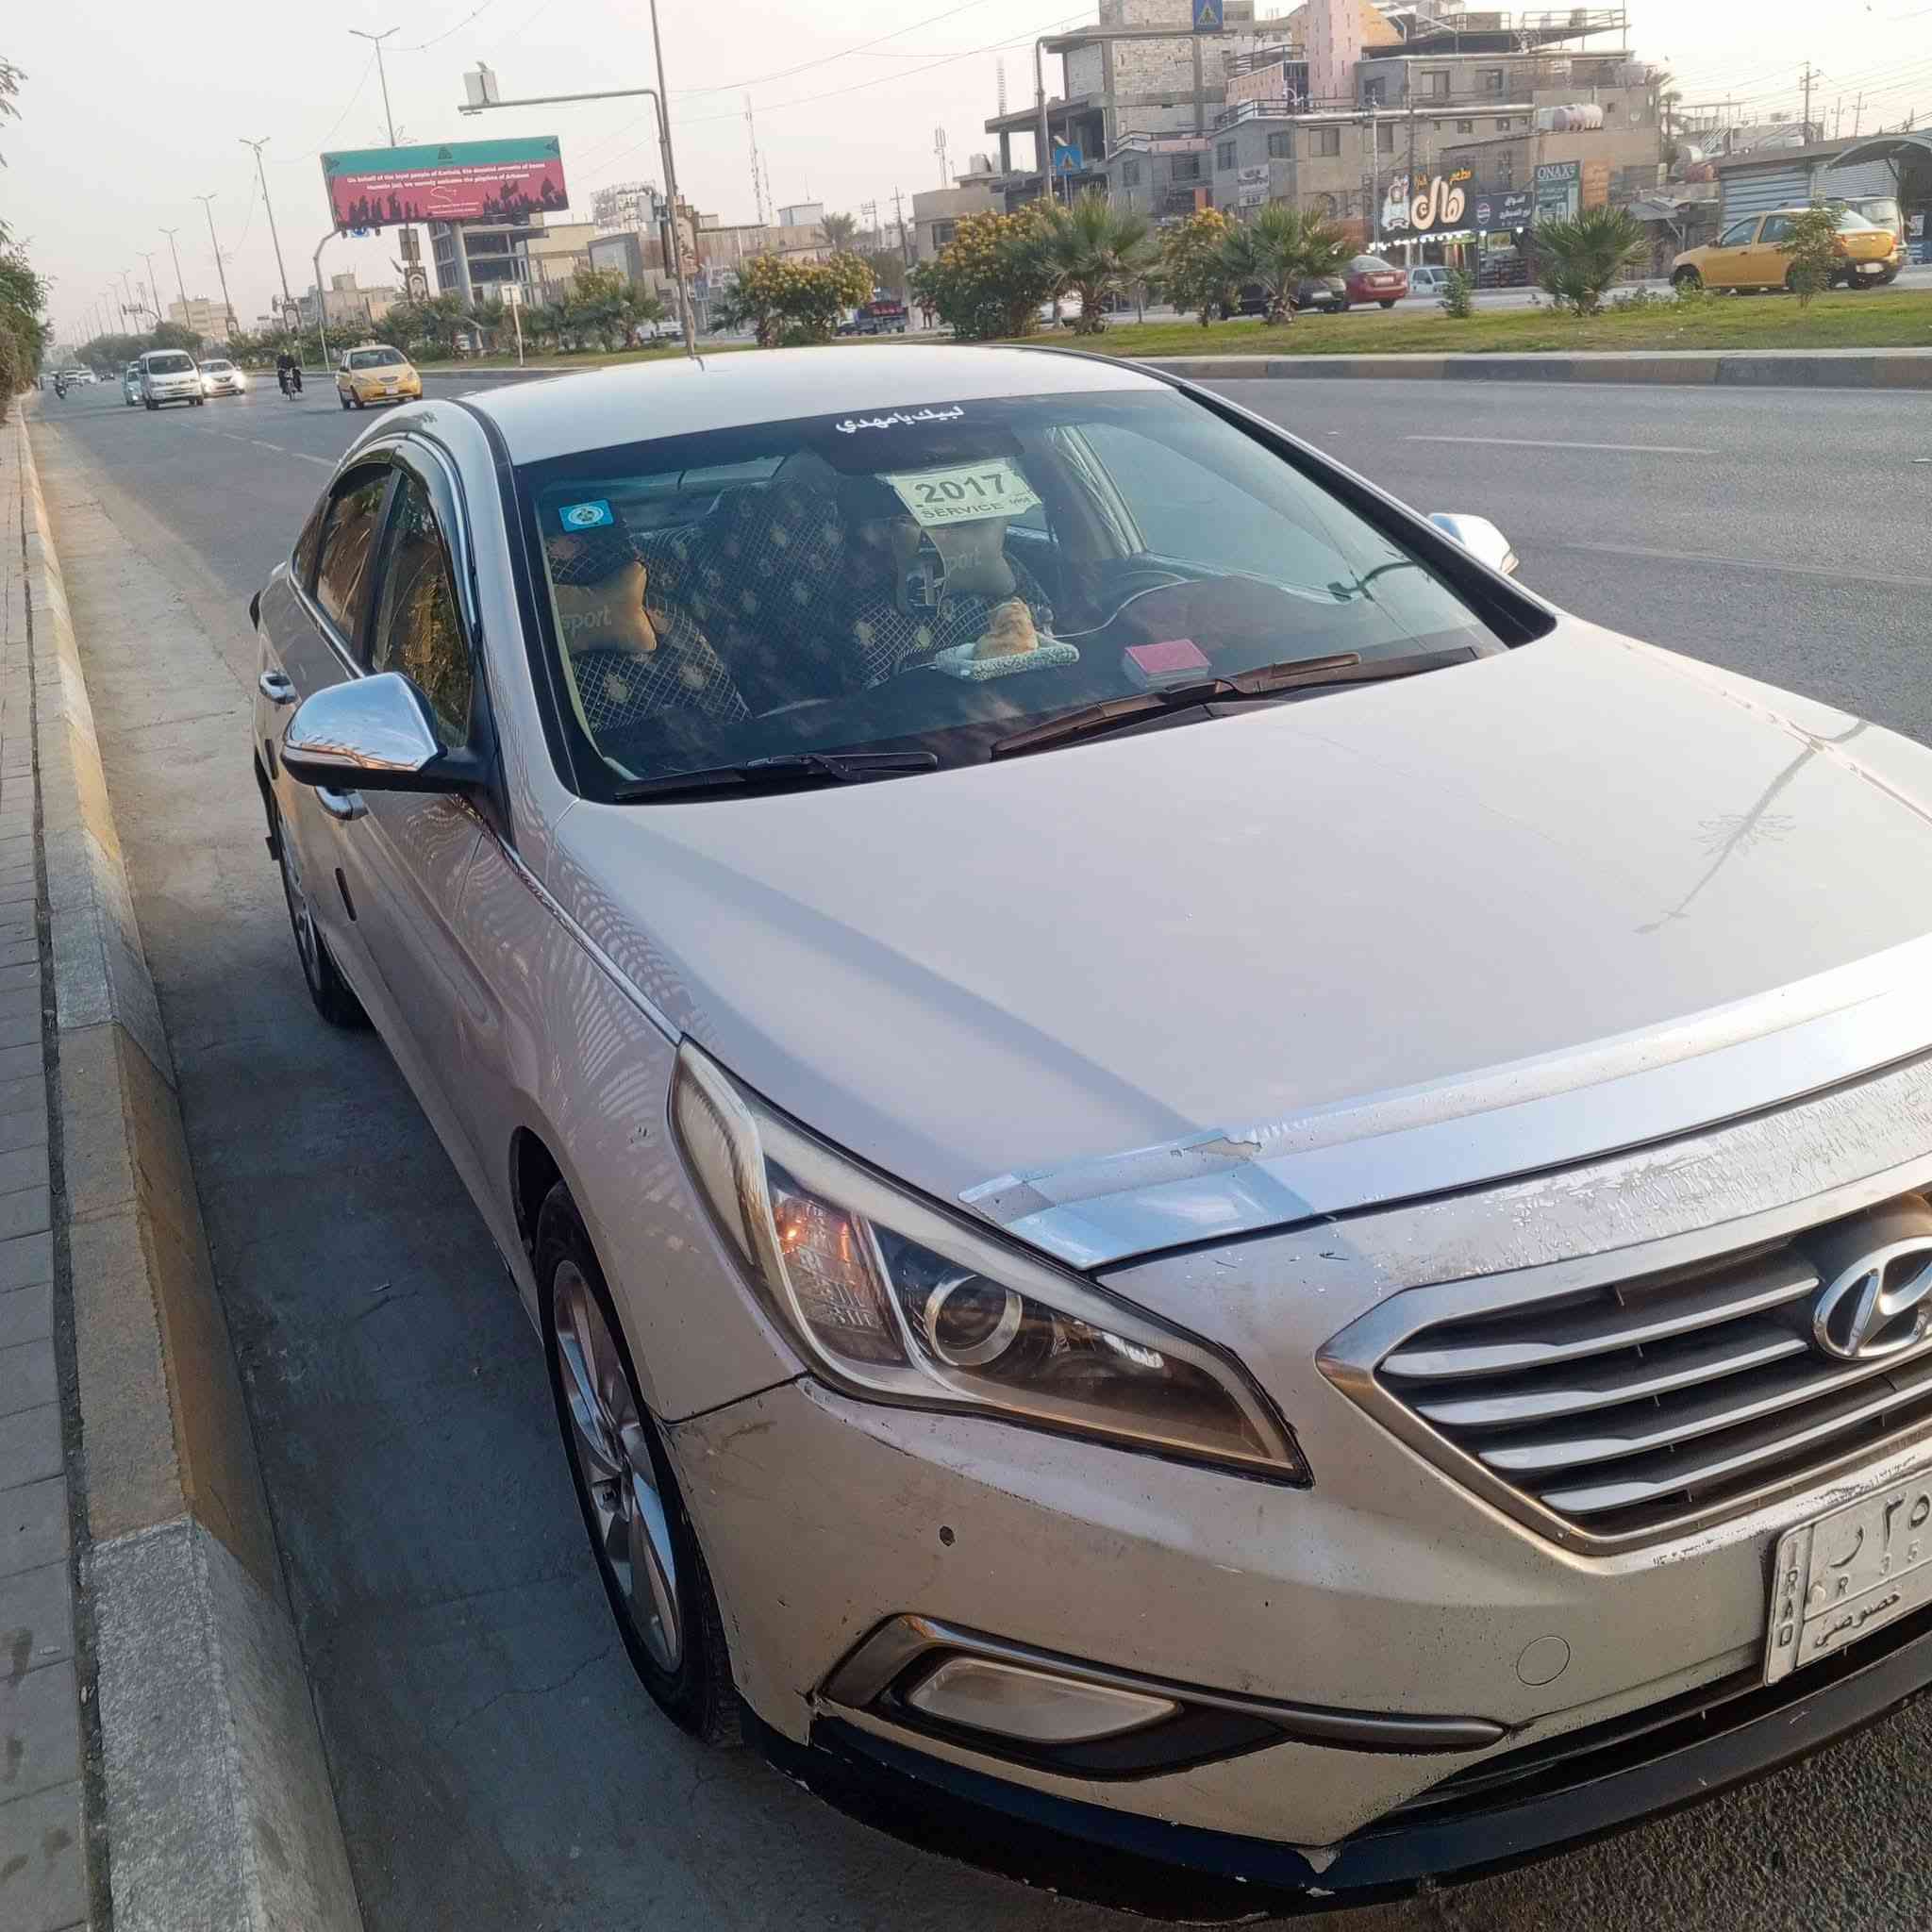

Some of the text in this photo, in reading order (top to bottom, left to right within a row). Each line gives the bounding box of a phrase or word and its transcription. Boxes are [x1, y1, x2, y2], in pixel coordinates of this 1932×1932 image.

[912, 406, 964, 421] لبيك
[915, 474, 1005, 504] 2017
[921, 504, 1005, 519] SERVICE
